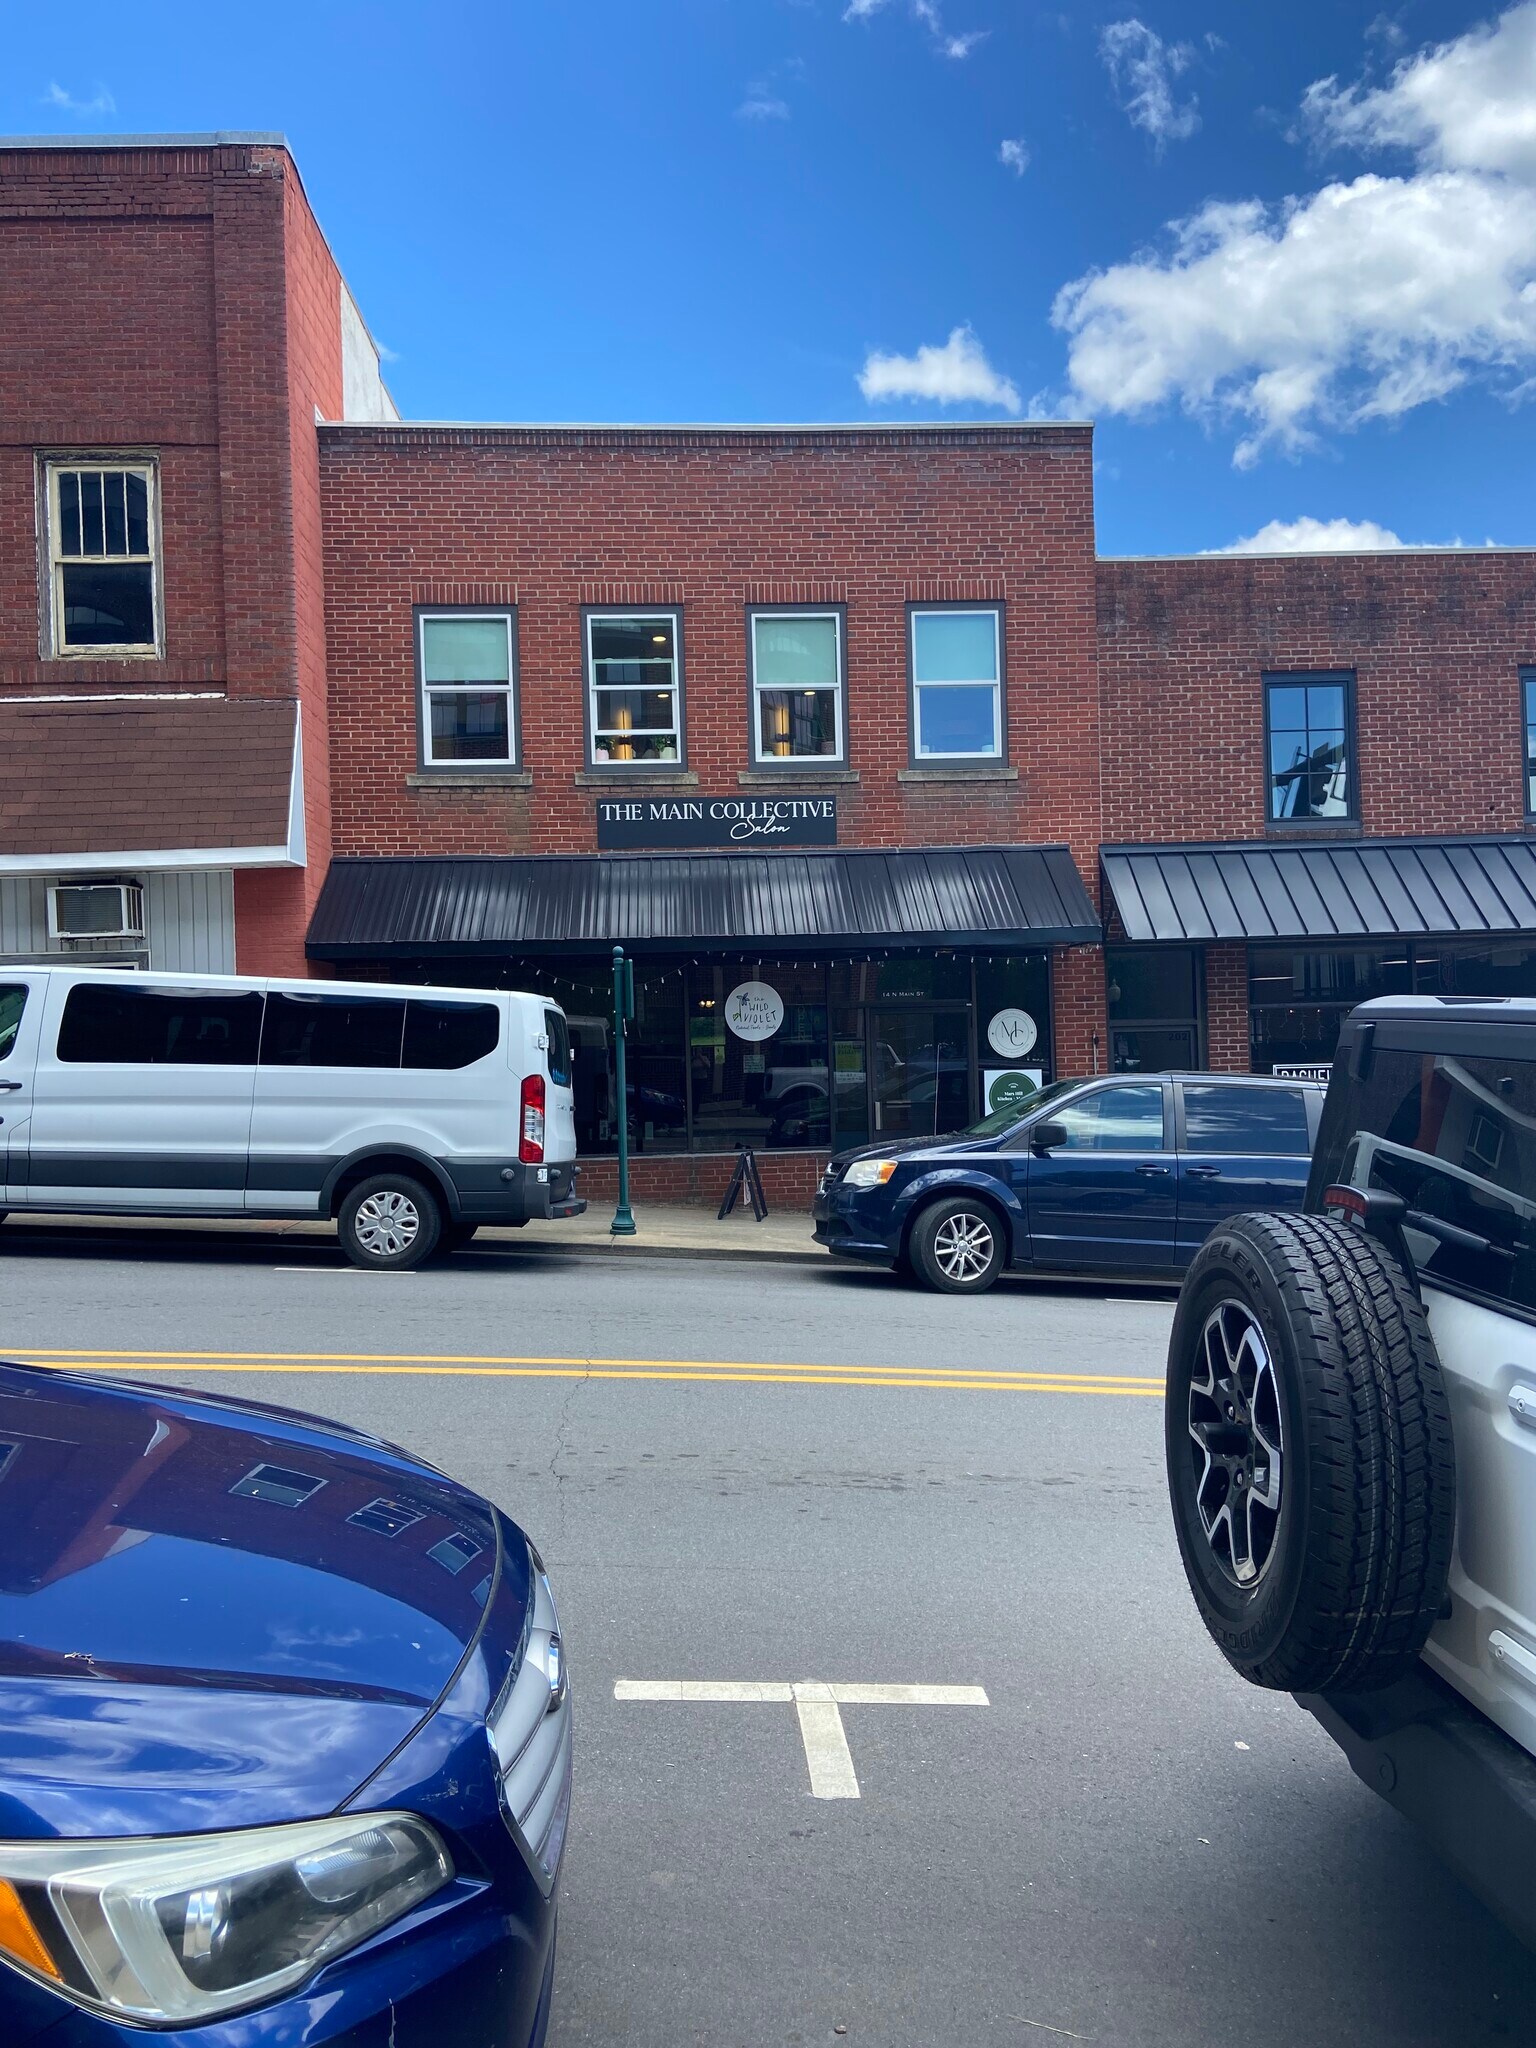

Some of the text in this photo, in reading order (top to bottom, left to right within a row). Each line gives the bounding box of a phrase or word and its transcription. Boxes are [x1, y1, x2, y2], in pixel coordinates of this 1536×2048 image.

[600, 800, 834, 821] THE MAIN COLLECTIVE
[730, 813, 790, 840] Salon
[748, 1002, 769, 1012] WILD
[744, 1009, 776, 1024] VIOLET
[1168, 1032, 1188, 1041] 202
